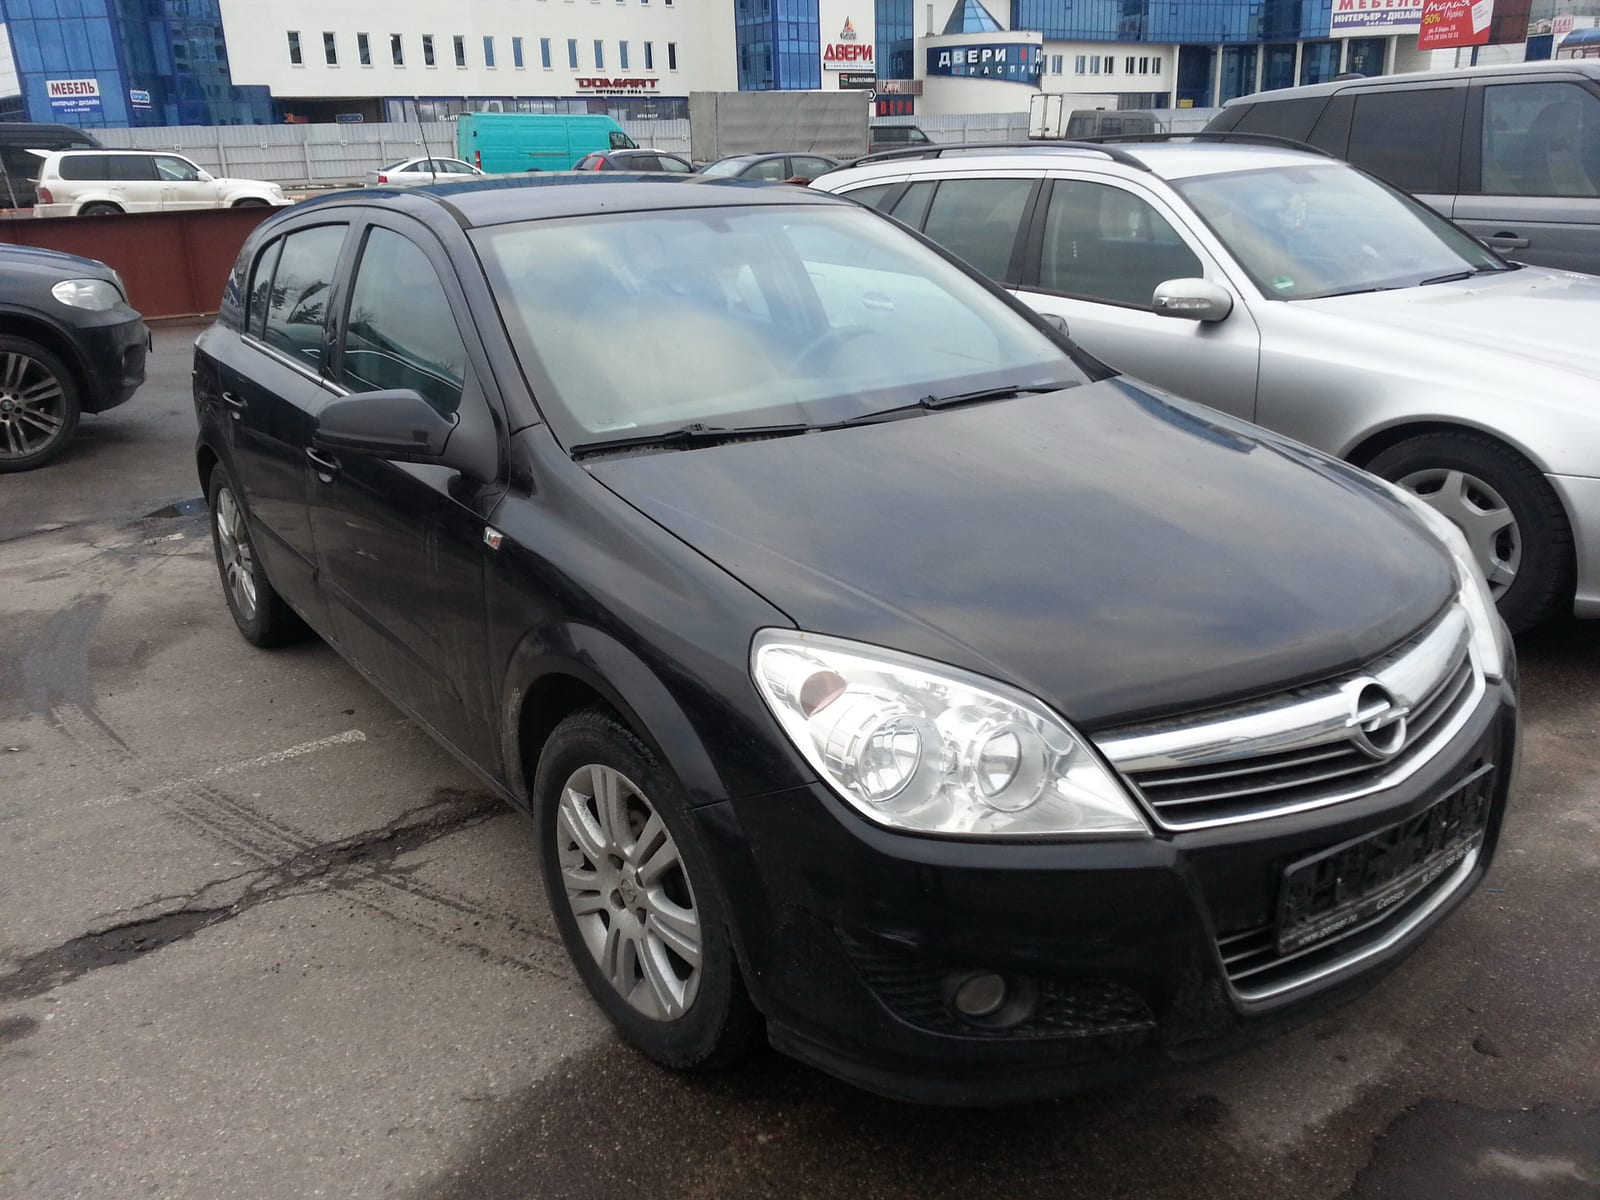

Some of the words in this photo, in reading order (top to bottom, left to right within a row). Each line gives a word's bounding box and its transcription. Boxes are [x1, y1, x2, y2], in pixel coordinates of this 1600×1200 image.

[1334, 12, 1381, 23] ИНТЕРЬЕР
[1387, 9, 1422, 20] ДИЗАЙН
[824, 44, 873, 61] ДВЕРИ
[939, 48, 1007, 67] ДВЕРИ
[970, 65, 1039, 75] РАСПРО
[51, 82, 95, 95] МЕБЕЛЬ
[876, 100, 913, 115] ВЕРИ
